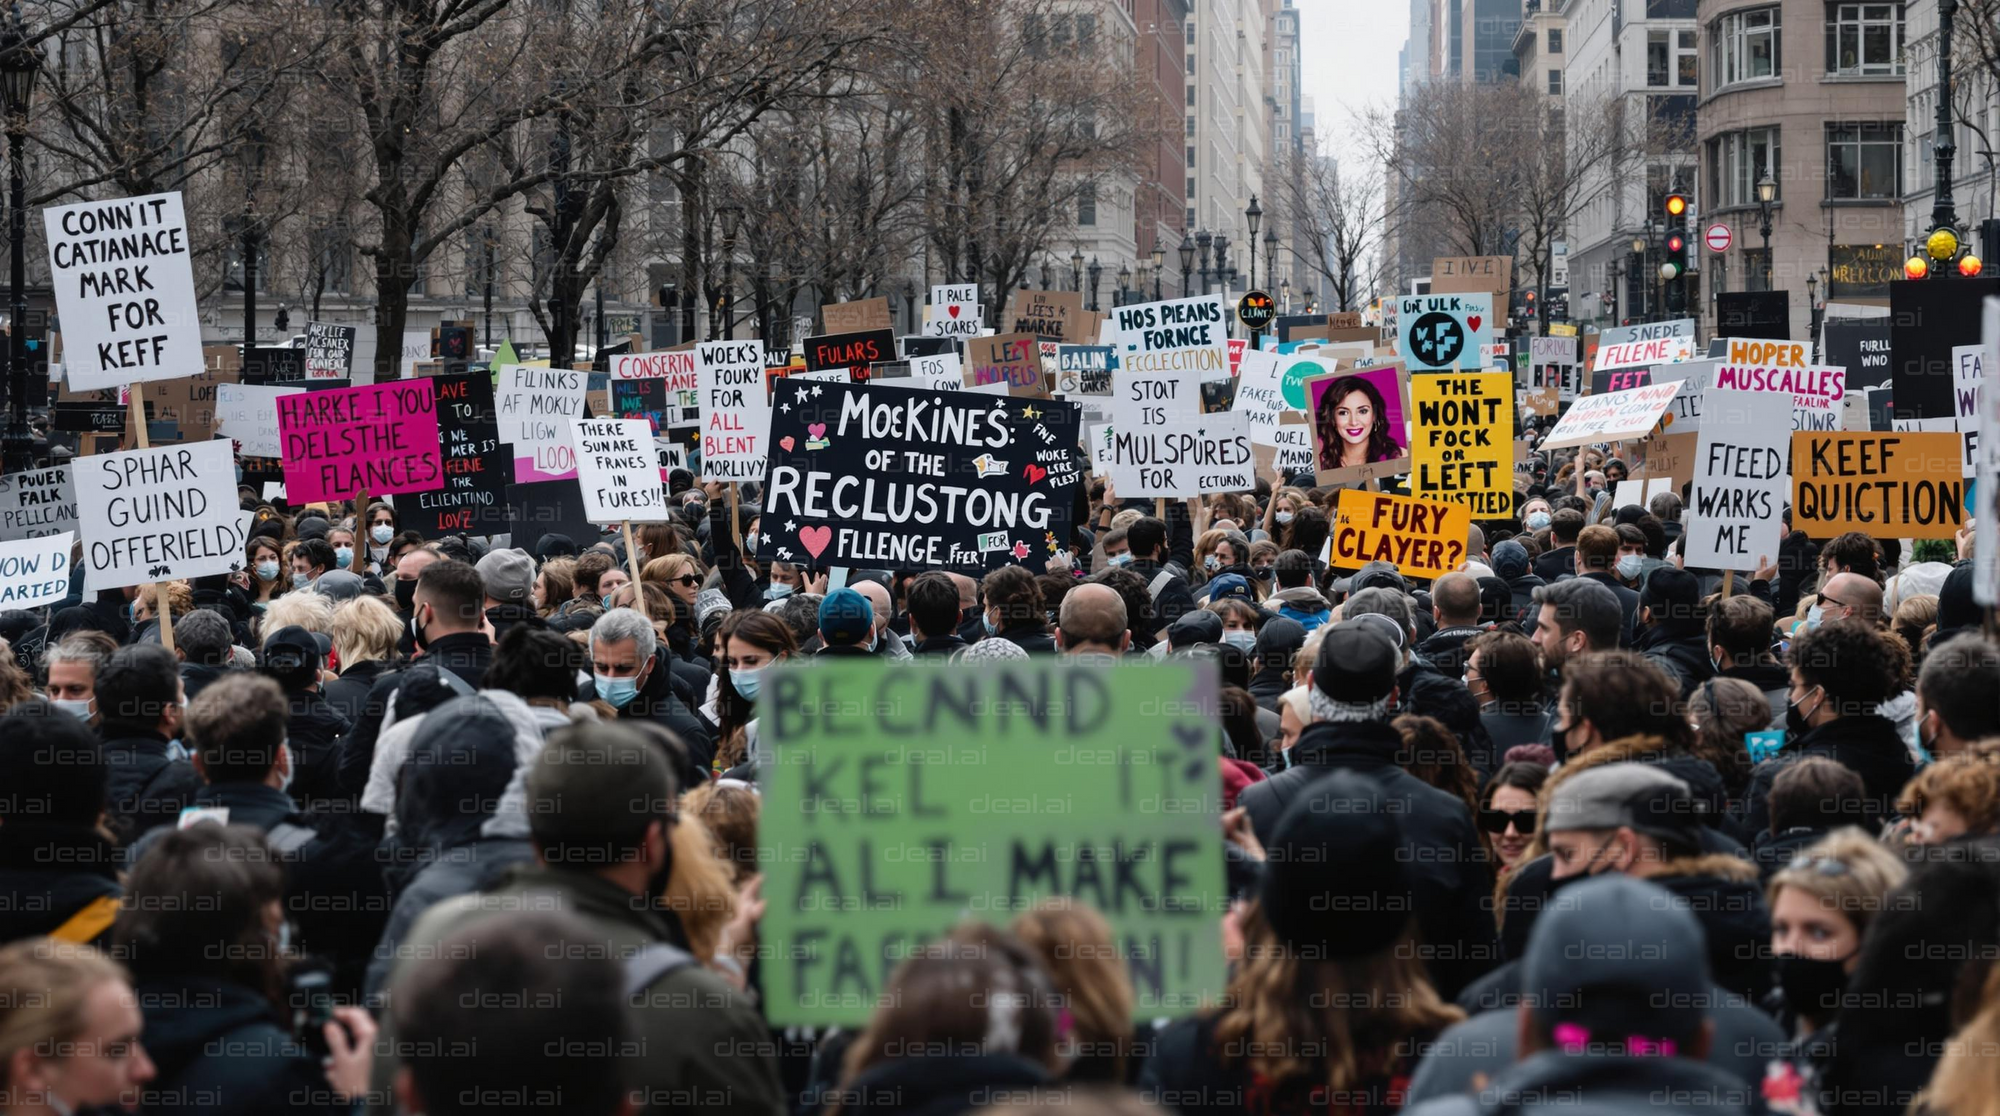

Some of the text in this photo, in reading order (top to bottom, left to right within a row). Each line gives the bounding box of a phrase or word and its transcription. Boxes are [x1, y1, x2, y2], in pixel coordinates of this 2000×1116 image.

[62, 199, 167, 236] CONN'IT
[54, 227, 185, 269] CATIANACE
[80, 265, 154, 298] MARK
[947, 288, 974, 303] RALE
[107, 298, 165, 332] FOR
[1119, 306, 1157, 331] HOS
[936, 320, 978, 337] SCARES
[1144, 325, 1212, 350] FORNCE
[98, 335, 168, 370] KEFF
[817, 340, 879, 366] FULARS
[1731, 341, 1806, 368] HOPER
[1861, 355, 1888, 367] WND
[920, 360, 944, 375] FOS
[1436, 379, 1483, 396] THE
[1608, 370, 1648, 392] FET
[1717, 366, 1845, 401] MUSCALLES
[281, 397, 366, 430] HARKE
[391, 387, 433, 417] YOU
[502, 394, 580, 415] AF MOKLY
[711, 389, 745, 408] FOR
[710, 412, 744, 431] ALL
[1419, 398, 1502, 427] WONT
[578, 422, 624, 436] THERE
[1429, 429, 1491, 447] FOCK
[705, 436, 756, 457] BLENT
[1036, 449, 1069, 462] WOKE
[1811, 438, 1901, 478] KEEF
[102, 450, 198, 490] SPHAR
[320, 452, 438, 496] FLANCES
[596, 456, 647, 470] FRAVES
[865, 449, 945, 477] OF THE
[1420, 461, 1498, 491] LEFT
[613, 475, 626, 487] IN
[1140, 468, 1177, 489] FOR
[19, 488, 62, 506] FALK
[107, 488, 207, 527] GUIND
[597, 487, 661, 509] FURES!!
[766, 466, 1052, 530] RECLUSTONG
[1697, 487, 1772, 520] WARKS
[1799, 480, 1961, 527] QUICTION
[1372, 497, 1448, 534] FURY
[988, 534, 1008, 548] FOR
[1714, 525, 1750, 554] ME
[805, 753, 949, 824] KEL
[1009, 836, 1202, 918] MAKE
